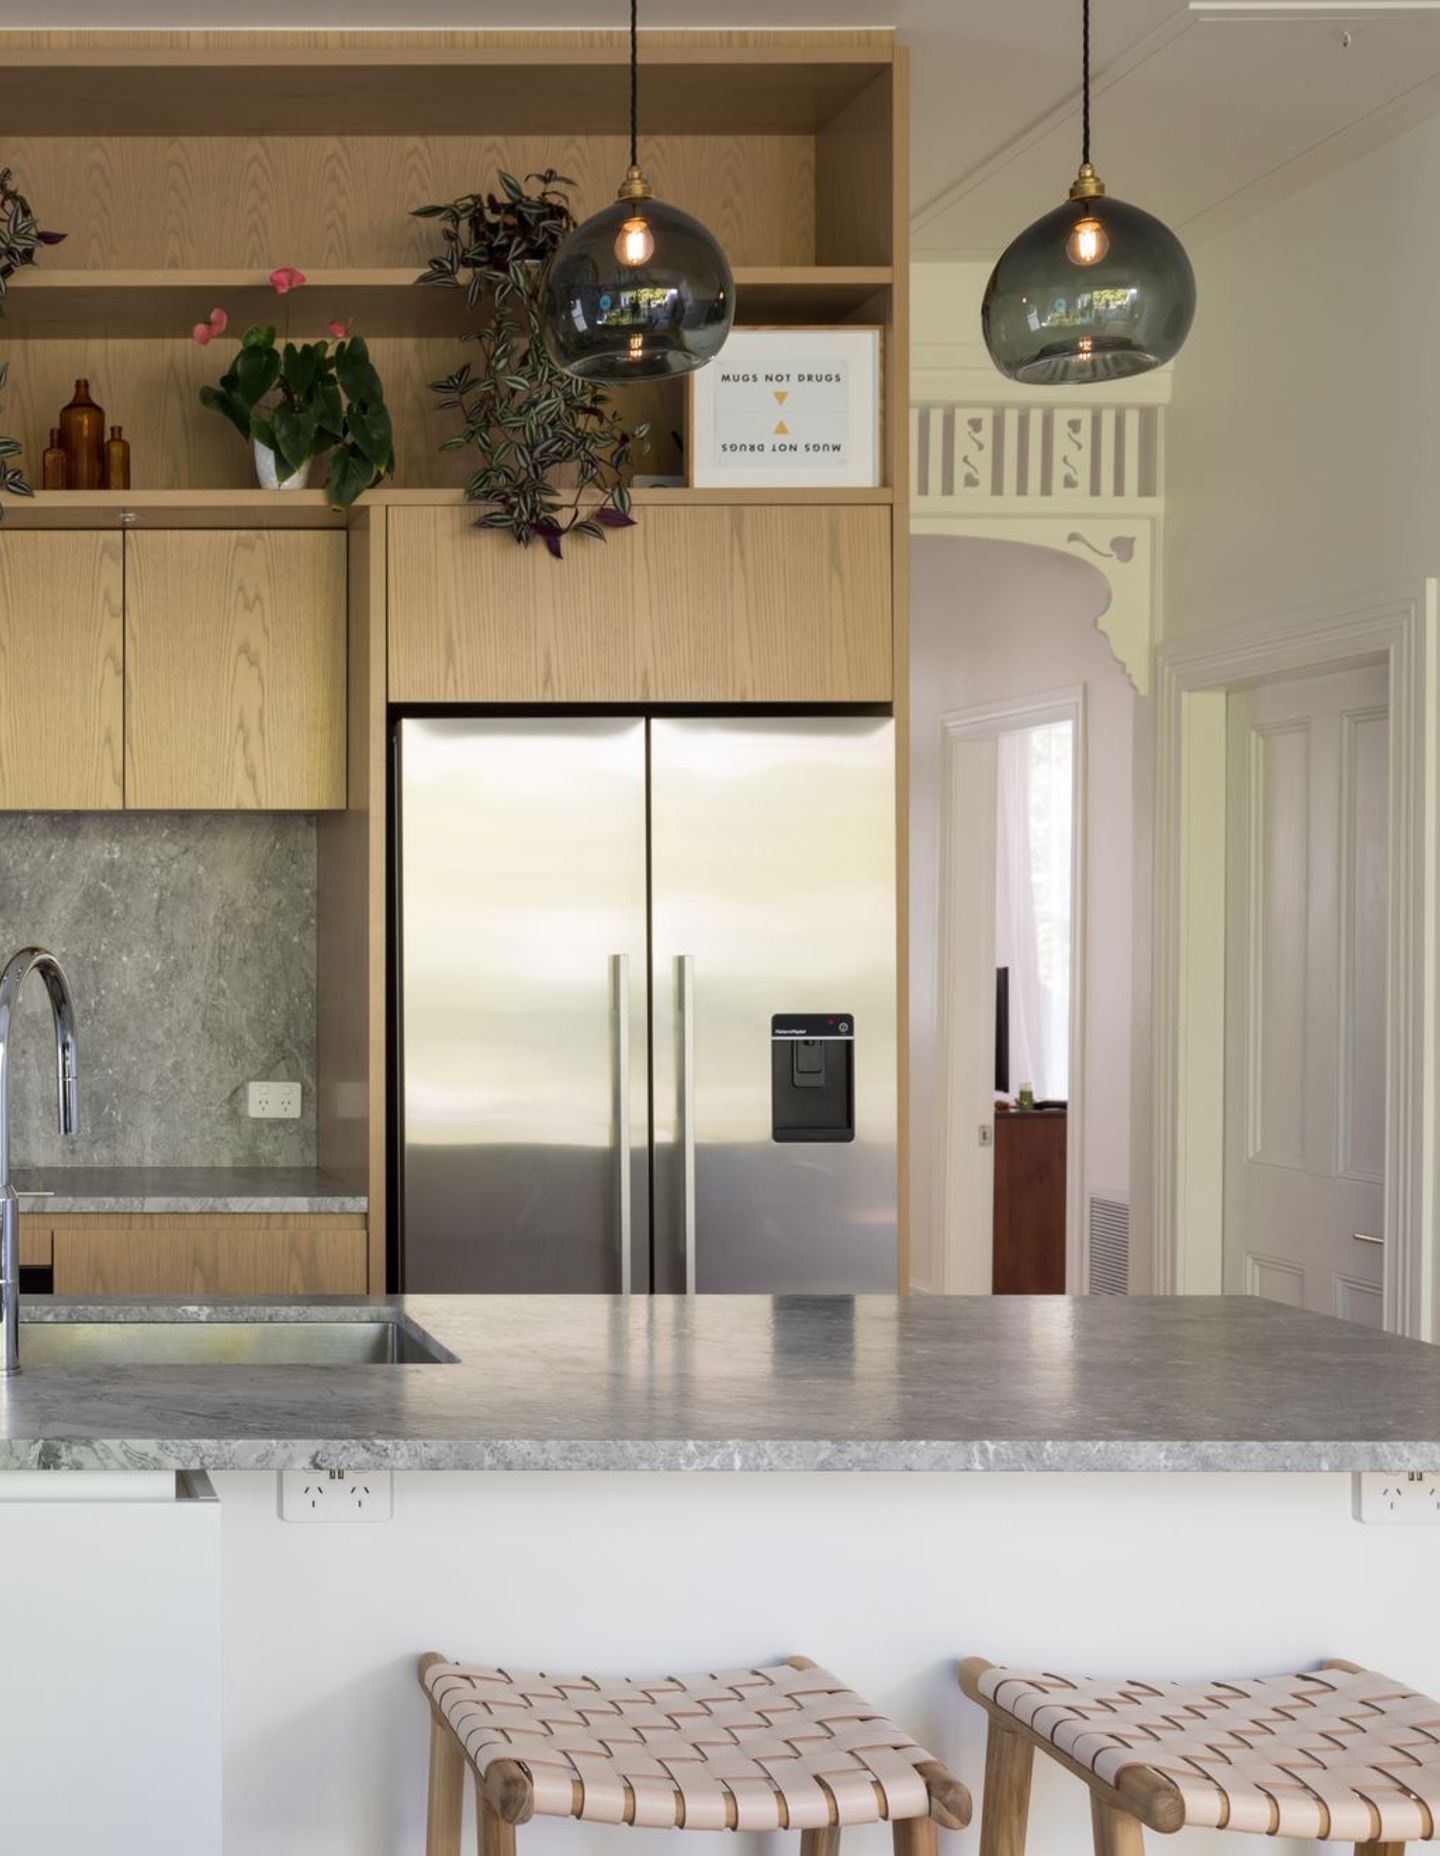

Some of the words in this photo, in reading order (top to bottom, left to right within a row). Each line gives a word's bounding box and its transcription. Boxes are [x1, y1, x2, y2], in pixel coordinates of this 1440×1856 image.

[721, 374, 758, 383] MUGS
[764, 374, 791, 383] NOT
[797, 374, 841, 383] DRUGS
[721, 443, 765, 452] DRUGS
[771, 443, 798, 452] NOT
[804, 443, 841, 452] MUGS
